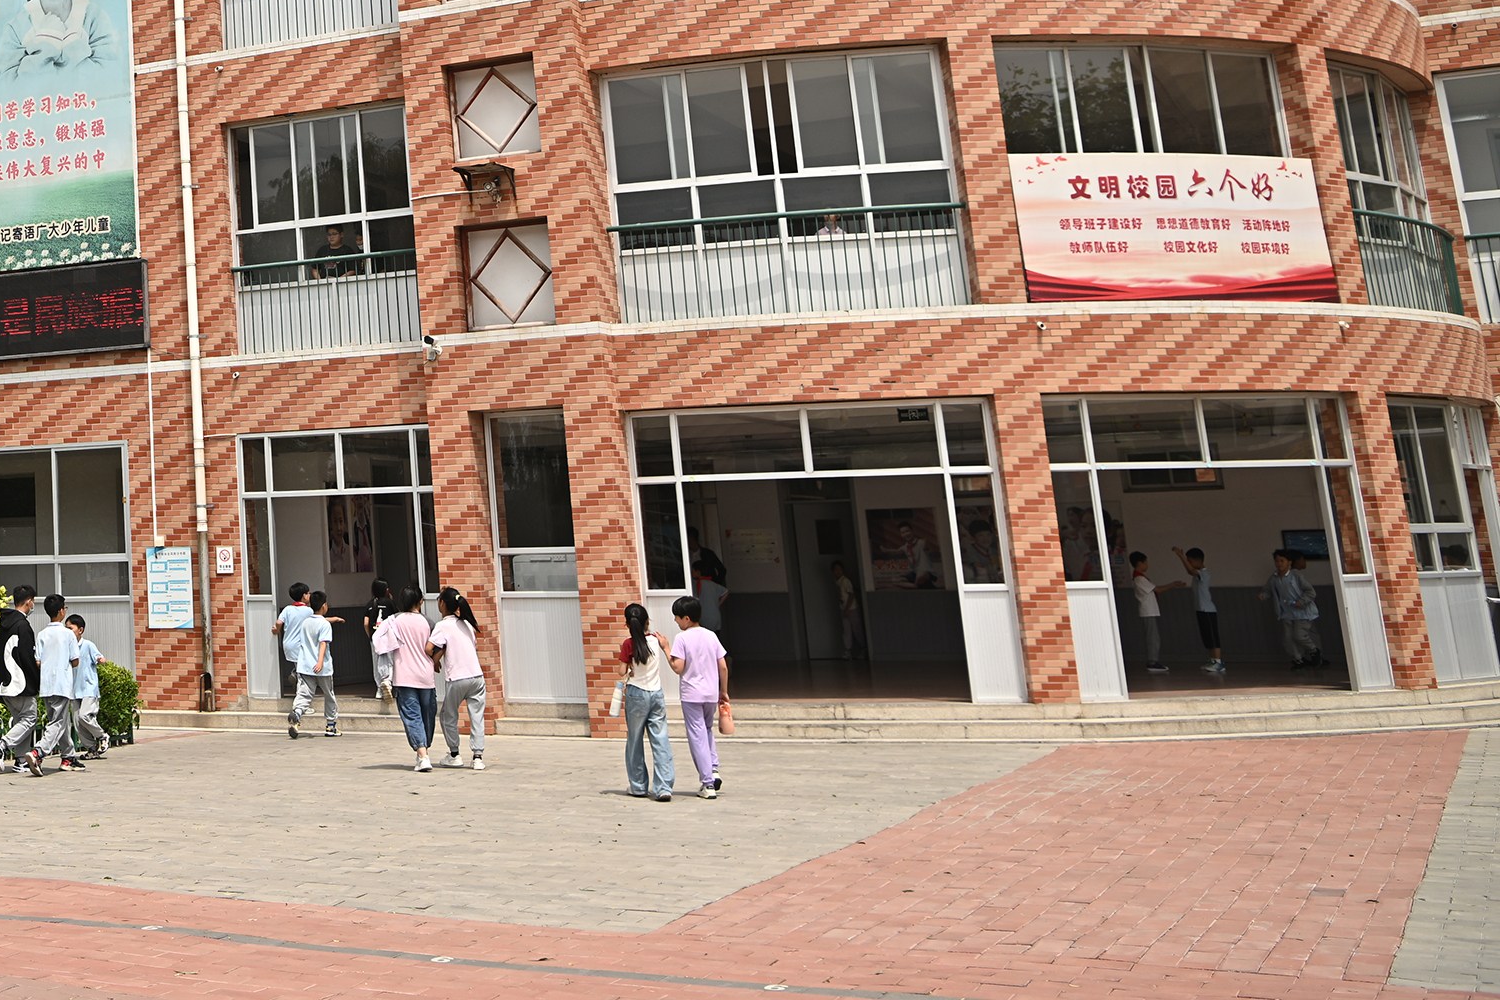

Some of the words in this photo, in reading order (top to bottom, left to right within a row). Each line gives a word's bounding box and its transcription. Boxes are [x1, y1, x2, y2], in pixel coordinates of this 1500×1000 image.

[1068, 168, 1274, 201] 文明校园六个好
[1059, 217, 1143, 231] 领导班子建设好
[1156, 217, 1231, 231] 思想道德教育好
[1242, 218, 1291, 232] 活动阵地好
[1070, 241, 1129, 254] 教师队伍好
[1163, 240, 1218, 254] 校园文化好
[1241, 241, 1290, 255] 校园环境好
